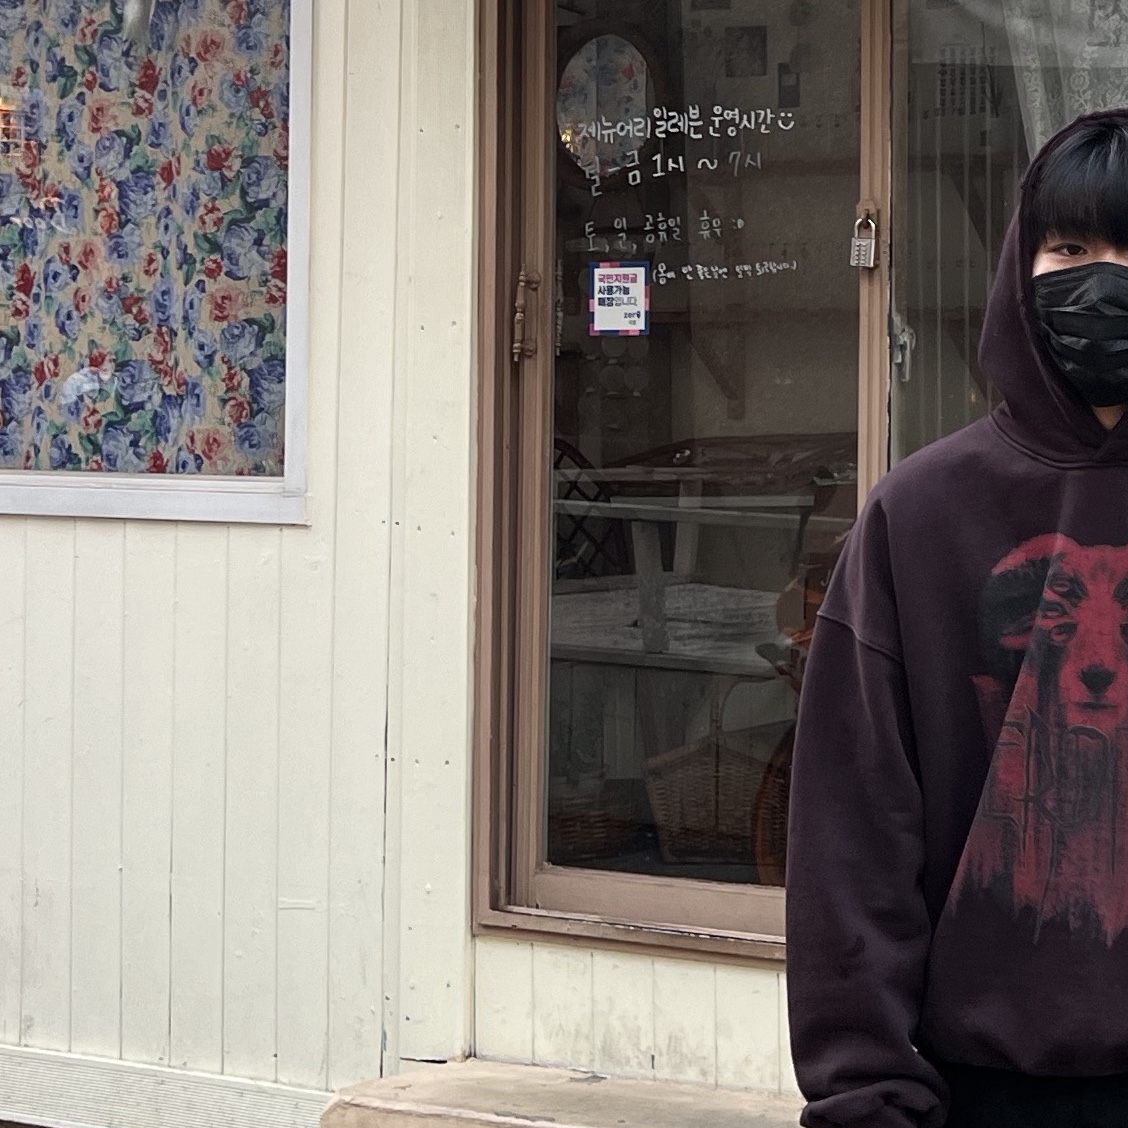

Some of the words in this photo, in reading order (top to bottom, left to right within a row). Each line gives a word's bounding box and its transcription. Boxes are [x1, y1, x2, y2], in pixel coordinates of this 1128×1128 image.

[708, 105, 775, 137] 운영시간
[652, 153, 685, 177] 1시
[728, 151, 762, 177] 7시
[643, 212, 681, 243] 공휴일
[698, 209, 722, 240] 휴무
[598, 273, 638, 284] 국민지원금
[598, 285, 630, 296] 사용가능
[598, 296, 638, 307] 매장입니다
